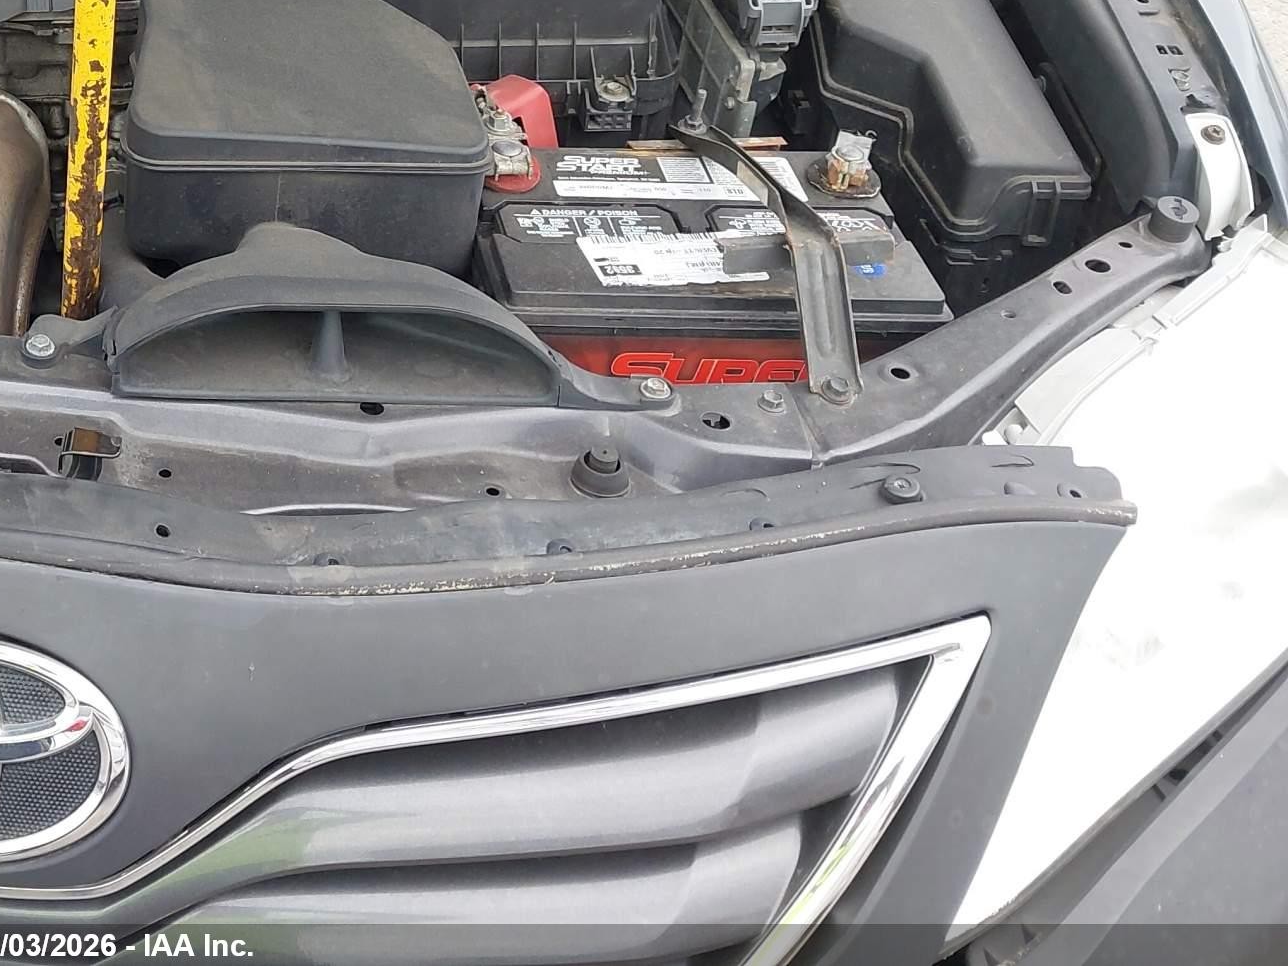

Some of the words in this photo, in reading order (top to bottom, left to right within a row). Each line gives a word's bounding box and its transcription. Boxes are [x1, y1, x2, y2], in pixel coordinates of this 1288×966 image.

[563, 155, 640, 165] SUPER
[556, 161, 642, 172] START
[611, 352, 806, 384] SUPE
